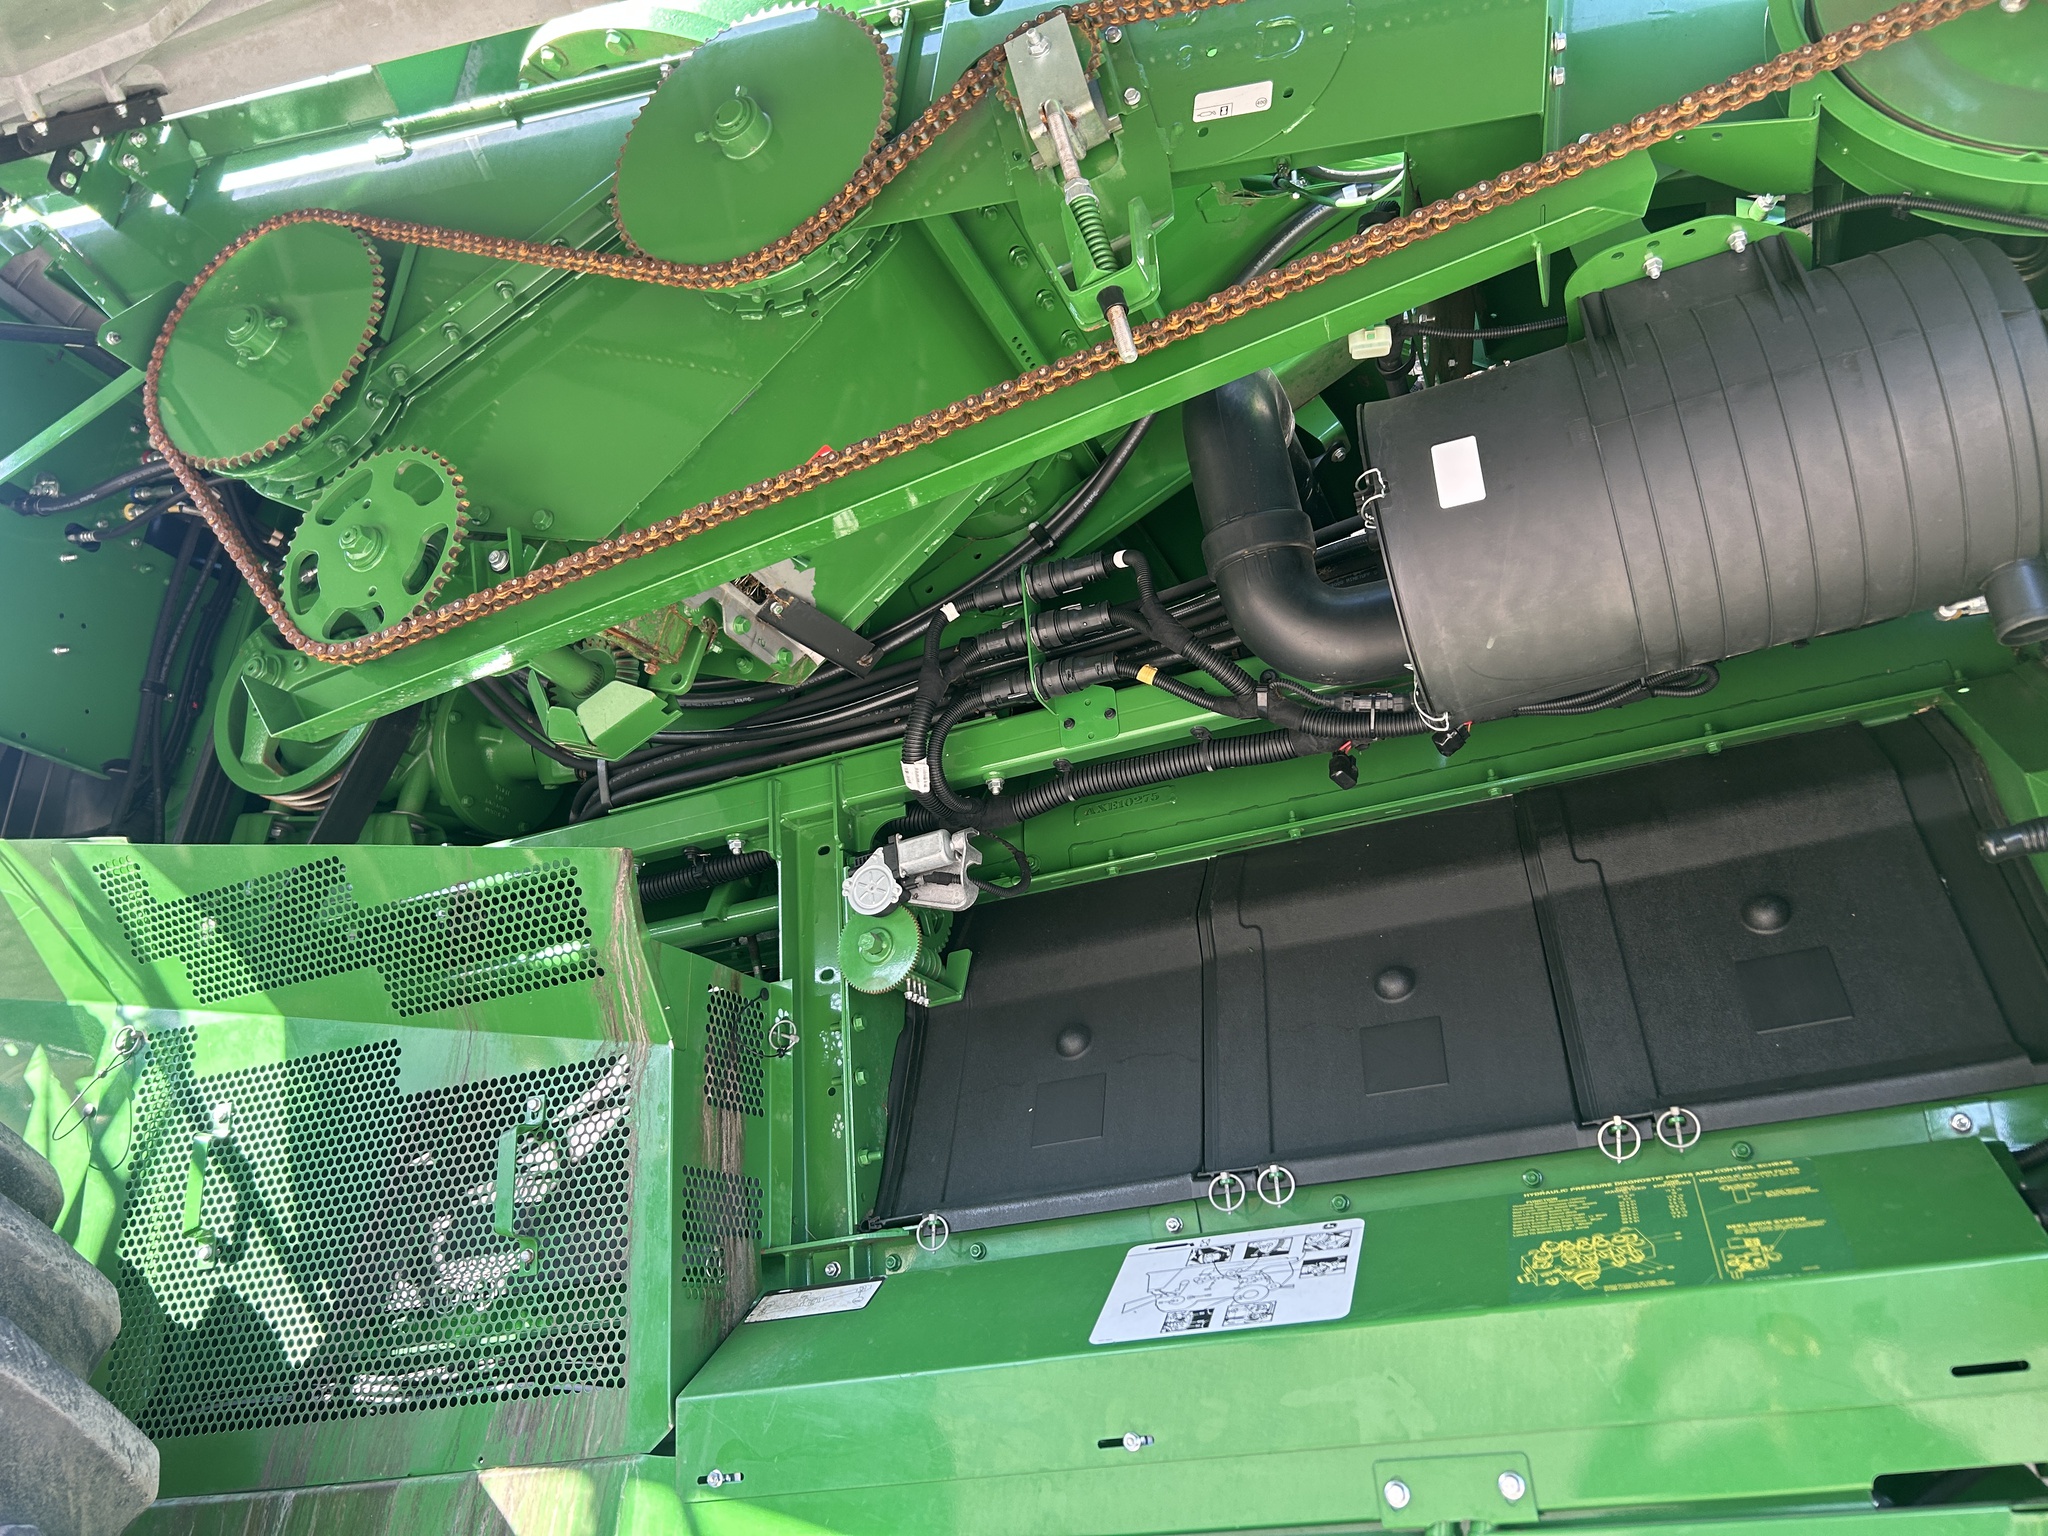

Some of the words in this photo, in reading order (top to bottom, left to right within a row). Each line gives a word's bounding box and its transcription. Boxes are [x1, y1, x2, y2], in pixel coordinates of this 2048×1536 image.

[1084, 792, 1160, 816] AXE10275
[1523, 1188, 1569, 1198] HYDRAULIC
[1569, 1182, 1613, 1192] PRESSURE
[1614, 1175, 1664, 1186] DIAGNOSTIC
[1665, 1172, 1694, 1180] PORTS
[1713, 1164, 1755, 1174] CONTROL
[1756, 1160, 1793, 1169] SCHEME
